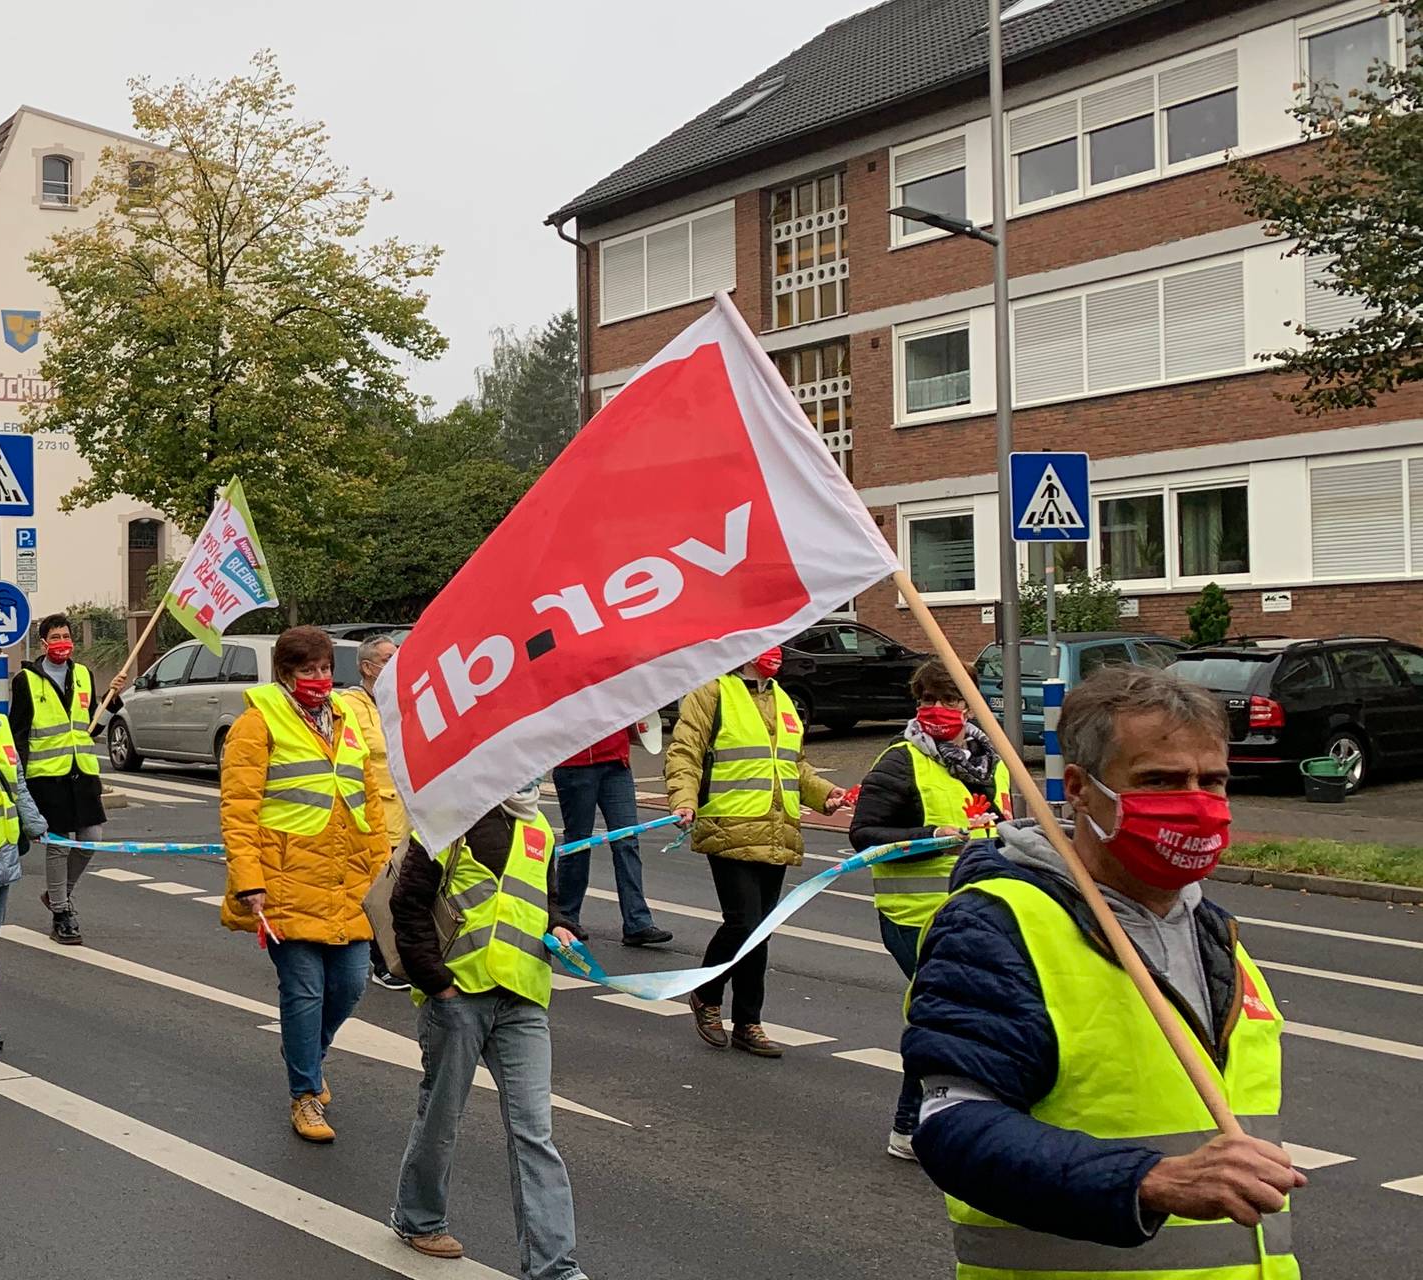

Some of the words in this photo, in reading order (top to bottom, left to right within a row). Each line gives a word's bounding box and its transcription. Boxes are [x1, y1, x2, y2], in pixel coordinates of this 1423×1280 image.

[19, 530, 31, 546] P
[226, 556, 265, 599] BLEIBEN
[1158, 828, 1183, 847] MIT
